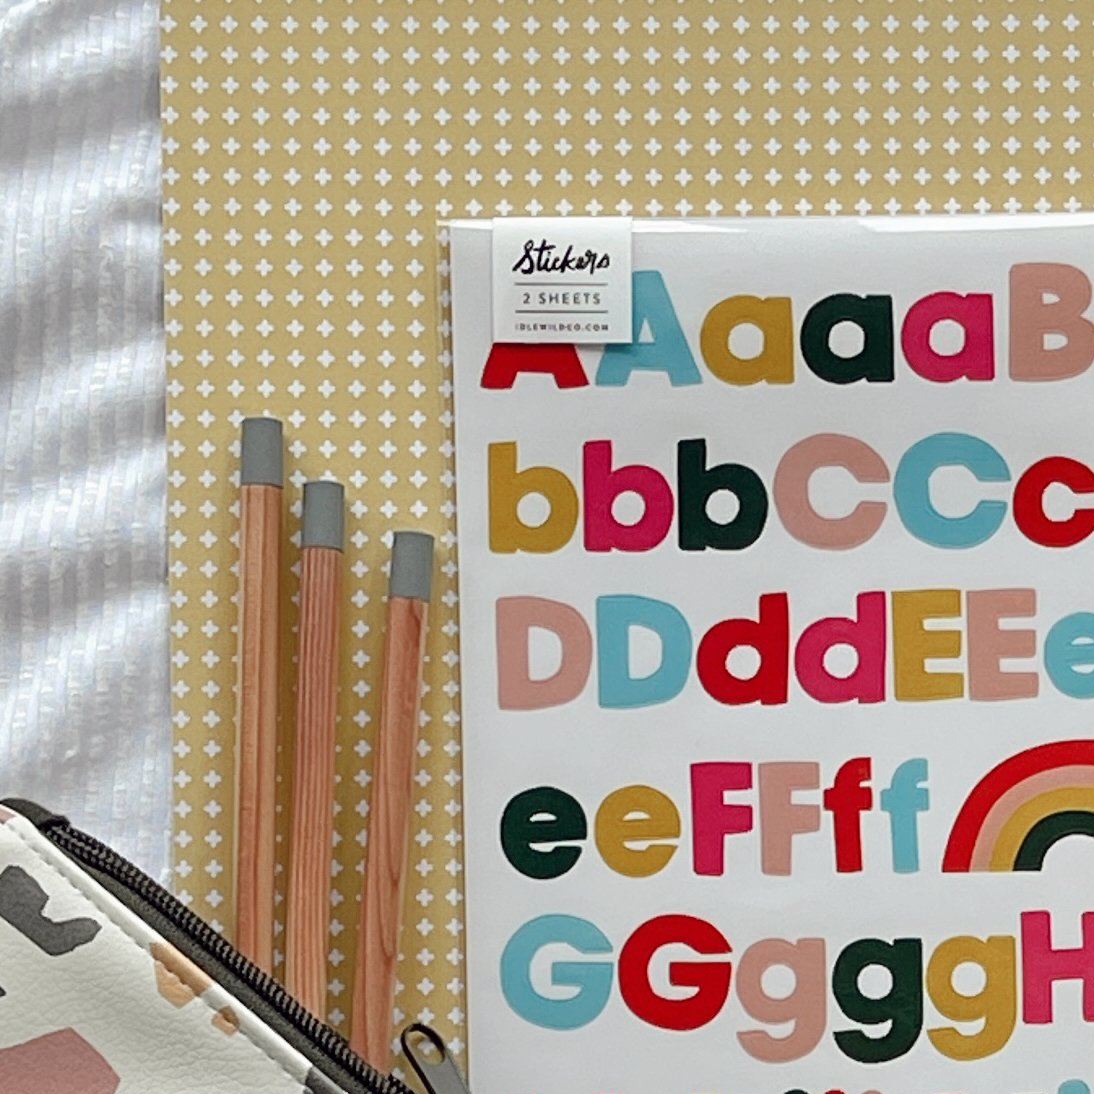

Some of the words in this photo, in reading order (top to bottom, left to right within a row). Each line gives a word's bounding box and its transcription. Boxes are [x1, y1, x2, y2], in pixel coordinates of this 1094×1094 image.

[512, 239, 610, 274] Stickers
[523, 292, 531, 305] 2
[538, 292, 601, 305] SHEETS
